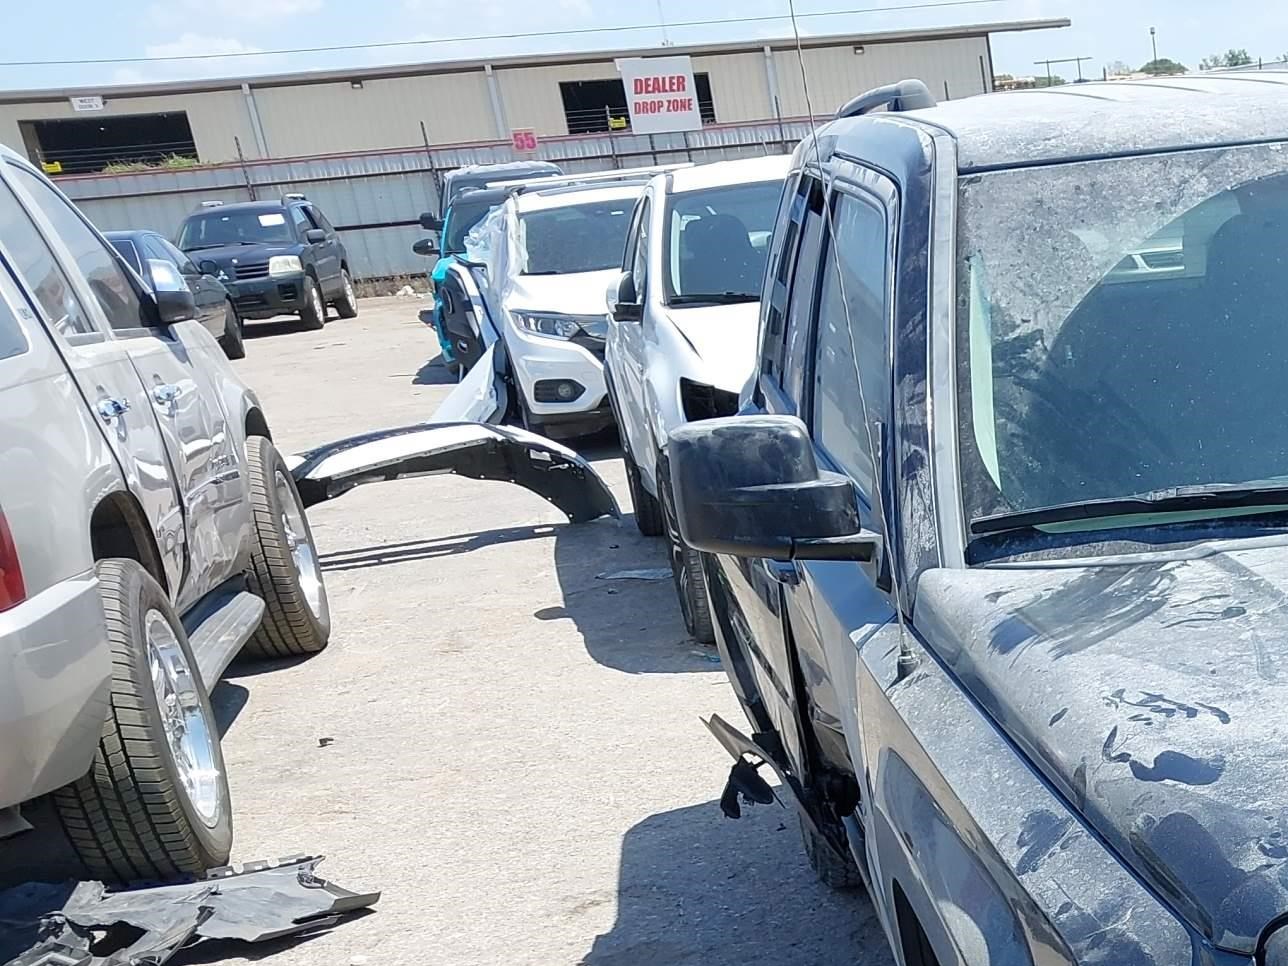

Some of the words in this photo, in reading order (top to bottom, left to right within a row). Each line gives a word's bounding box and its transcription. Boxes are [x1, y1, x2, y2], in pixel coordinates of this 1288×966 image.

[633, 75, 686, 95] DEALER
[633, 101, 664, 115] DROP
[666, 98, 693, 113] ZONE
[512, 132, 537, 150] 55
